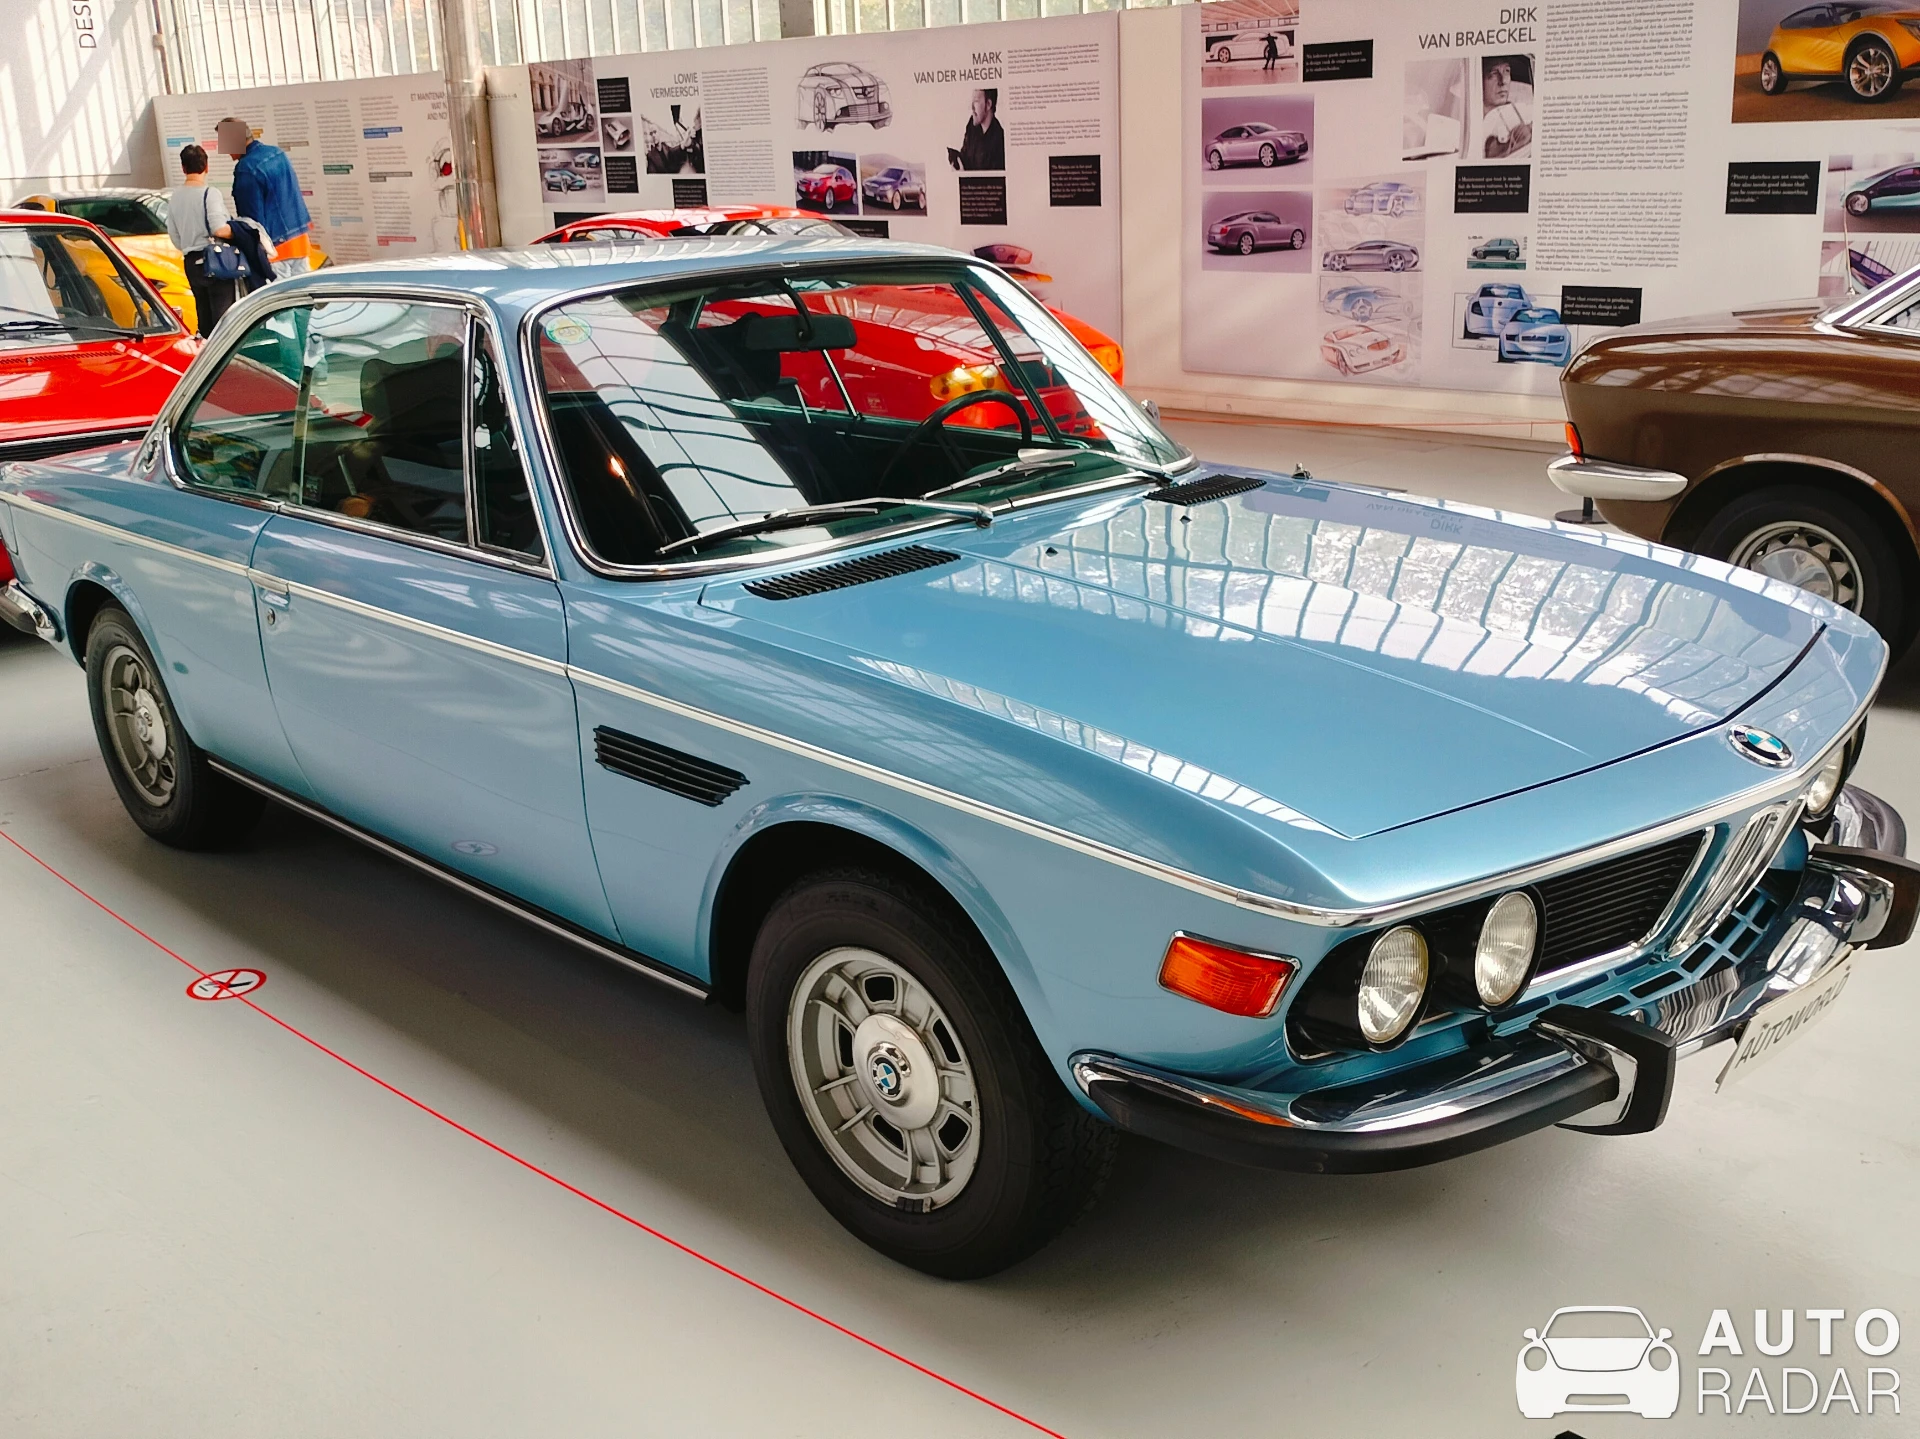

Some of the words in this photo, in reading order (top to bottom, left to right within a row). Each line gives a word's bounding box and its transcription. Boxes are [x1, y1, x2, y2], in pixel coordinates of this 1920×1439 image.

[1500, 7, 1538, 24] DIRK
[1419, 32, 1450, 49] VAN
[1456, 27, 1537, 47] BRAECKEL
[972, 52, 1002, 65] MARK
[673, 72, 698, 84] LOWIE
[914, 71, 934, 84] VAN
[937, 69, 957, 82] DER
[959, 67, 1002, 81] HAEGEN
[650, 86, 699, 98] VERMEERSCH
